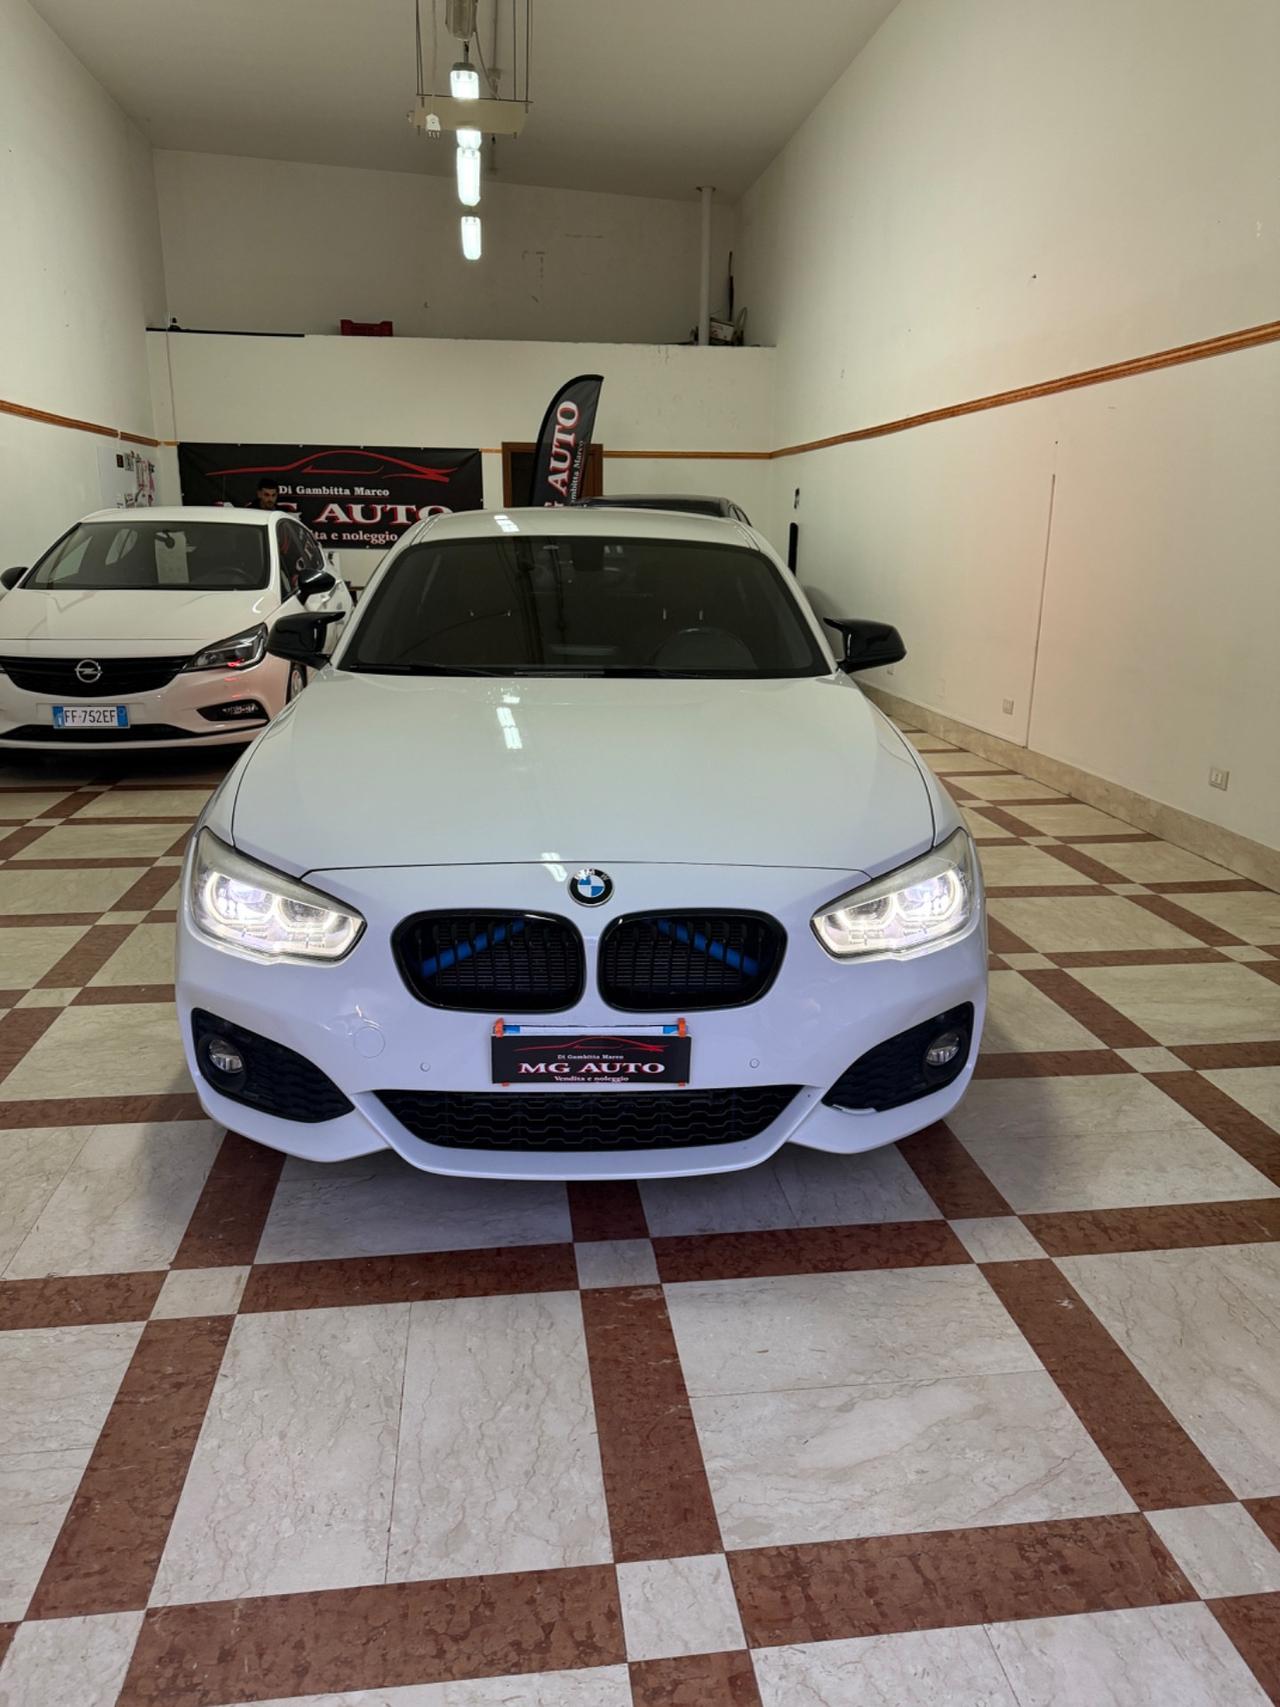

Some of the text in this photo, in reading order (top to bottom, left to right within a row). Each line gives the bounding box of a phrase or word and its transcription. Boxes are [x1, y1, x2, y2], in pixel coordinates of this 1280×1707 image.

[546, 400, 579, 497] AUTO
[278, 485, 390, 497] Di Gambitta Marco
[330, 532, 339, 541] e
[342, 530, 398, 545] noleggio
[519, 1062, 666, 1074] MG AUTO
[593, 1075, 630, 1083] noleggio
